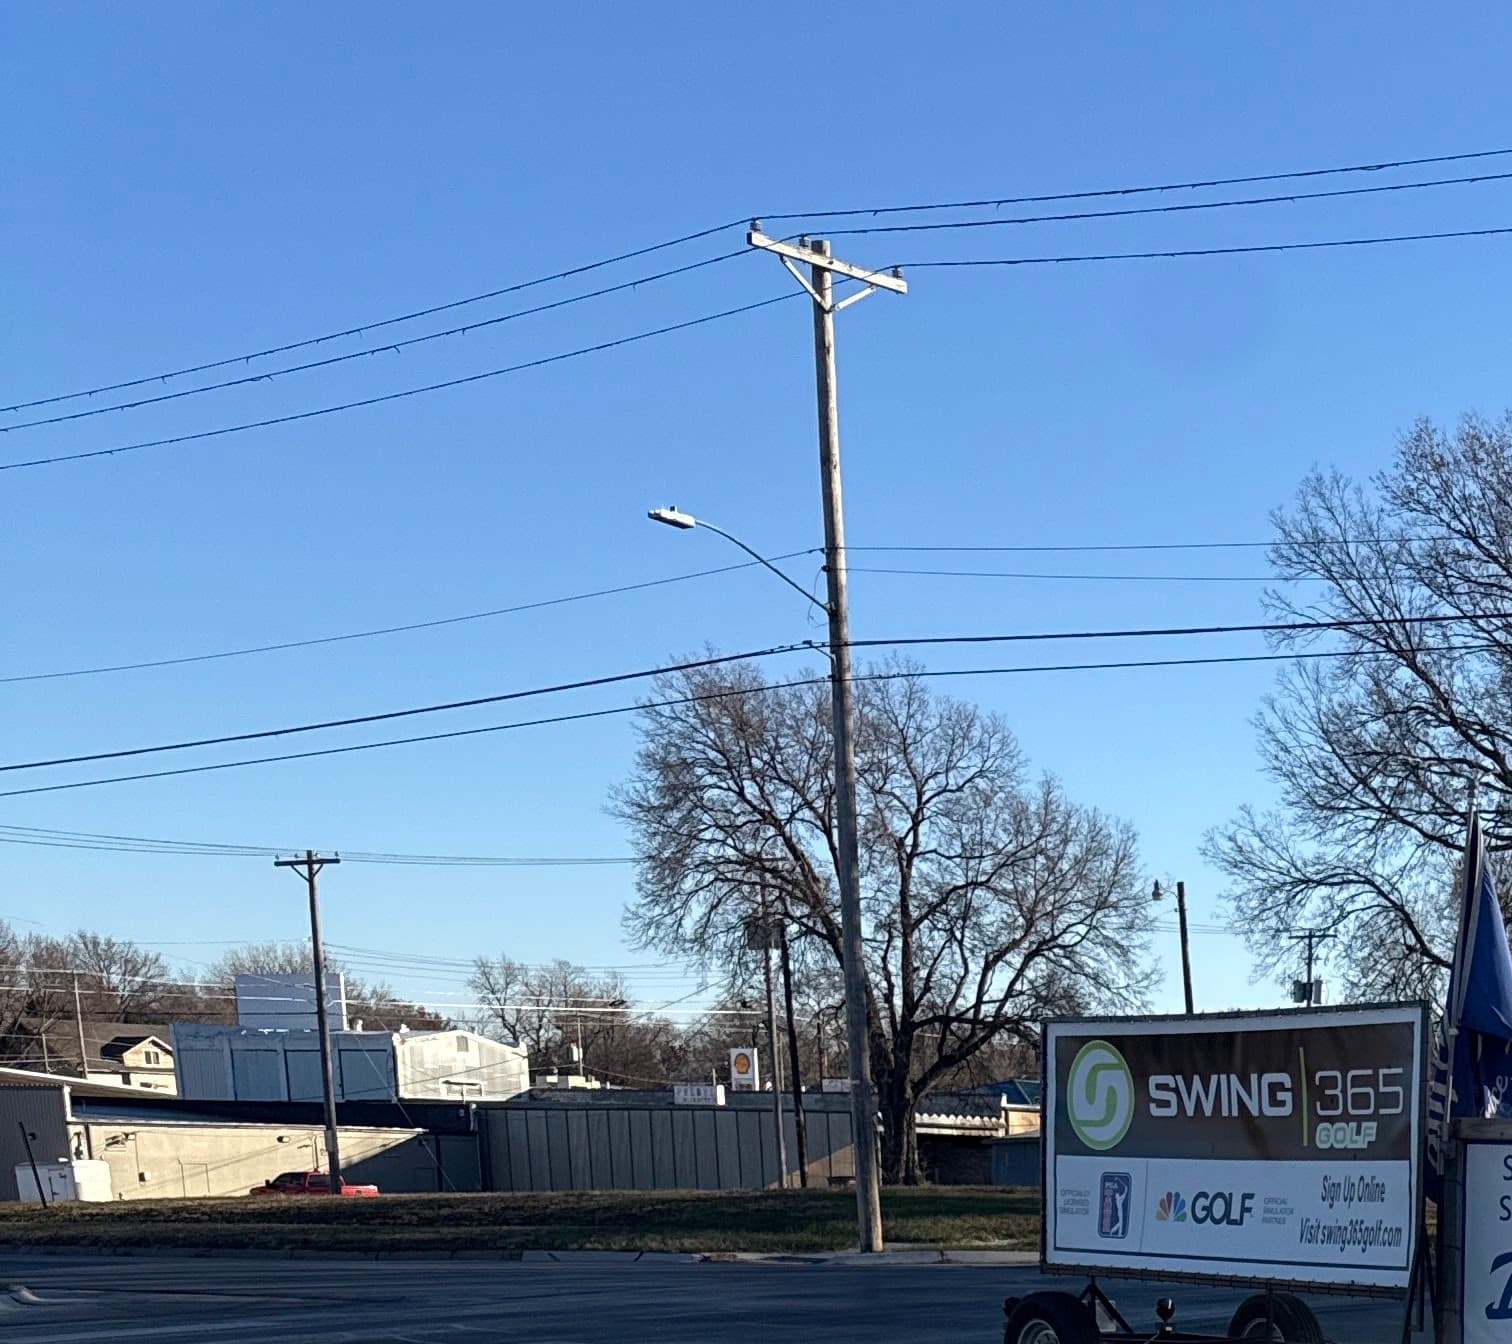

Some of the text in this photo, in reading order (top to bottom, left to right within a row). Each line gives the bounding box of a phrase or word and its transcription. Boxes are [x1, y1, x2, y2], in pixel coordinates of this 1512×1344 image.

[1148, 1067, 1404, 1118] SWING 365
[1315, 1121, 1378, 1149] GOLF
[1191, 1191, 1256, 1226] GOLF
[1321, 1175, 1385, 1209] Sign Up Online
[1299, 1218, 1402, 1253] Visit swing365golf.com
